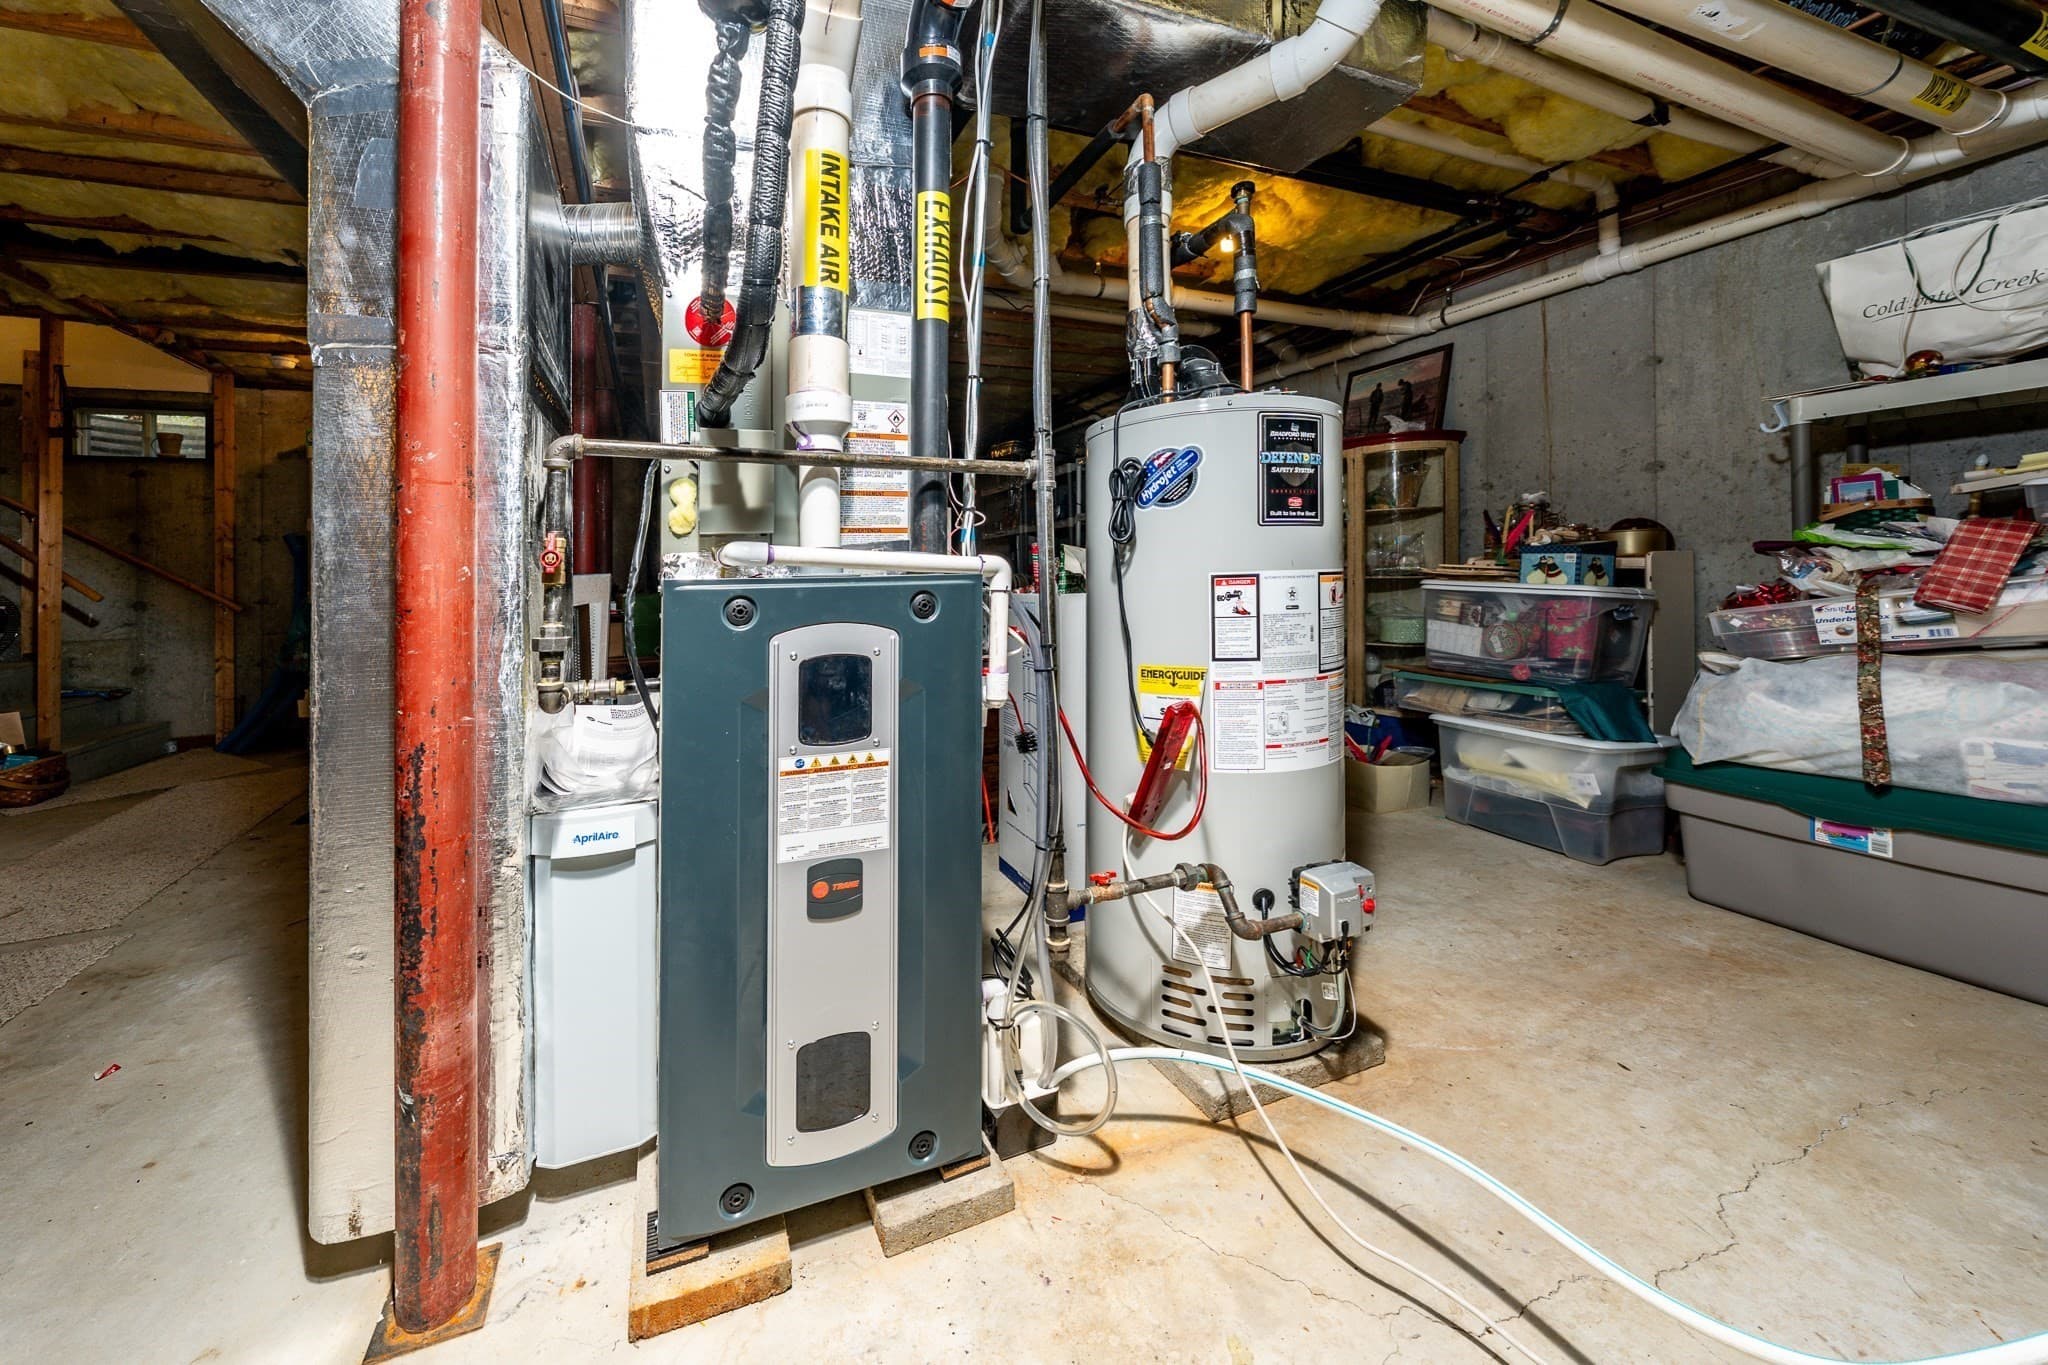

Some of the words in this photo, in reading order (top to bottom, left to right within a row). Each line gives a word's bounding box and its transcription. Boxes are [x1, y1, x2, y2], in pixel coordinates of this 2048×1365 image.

[819, 152, 841, 239] INTAKE
[819, 243, 840, 286] AIR
[923, 199, 950, 306] EXHAUST
[1976, 269, 2045, 294] Creek
[1260, 451, 1322, 465] DEFENDER
[1141, 465, 1177, 502] Hydrojet
[1815, 616, 1857, 624] Underbe
[1140, 669, 1206, 682] ENERGYGUIDE
[573, 831, 619, 845] AprilAire
